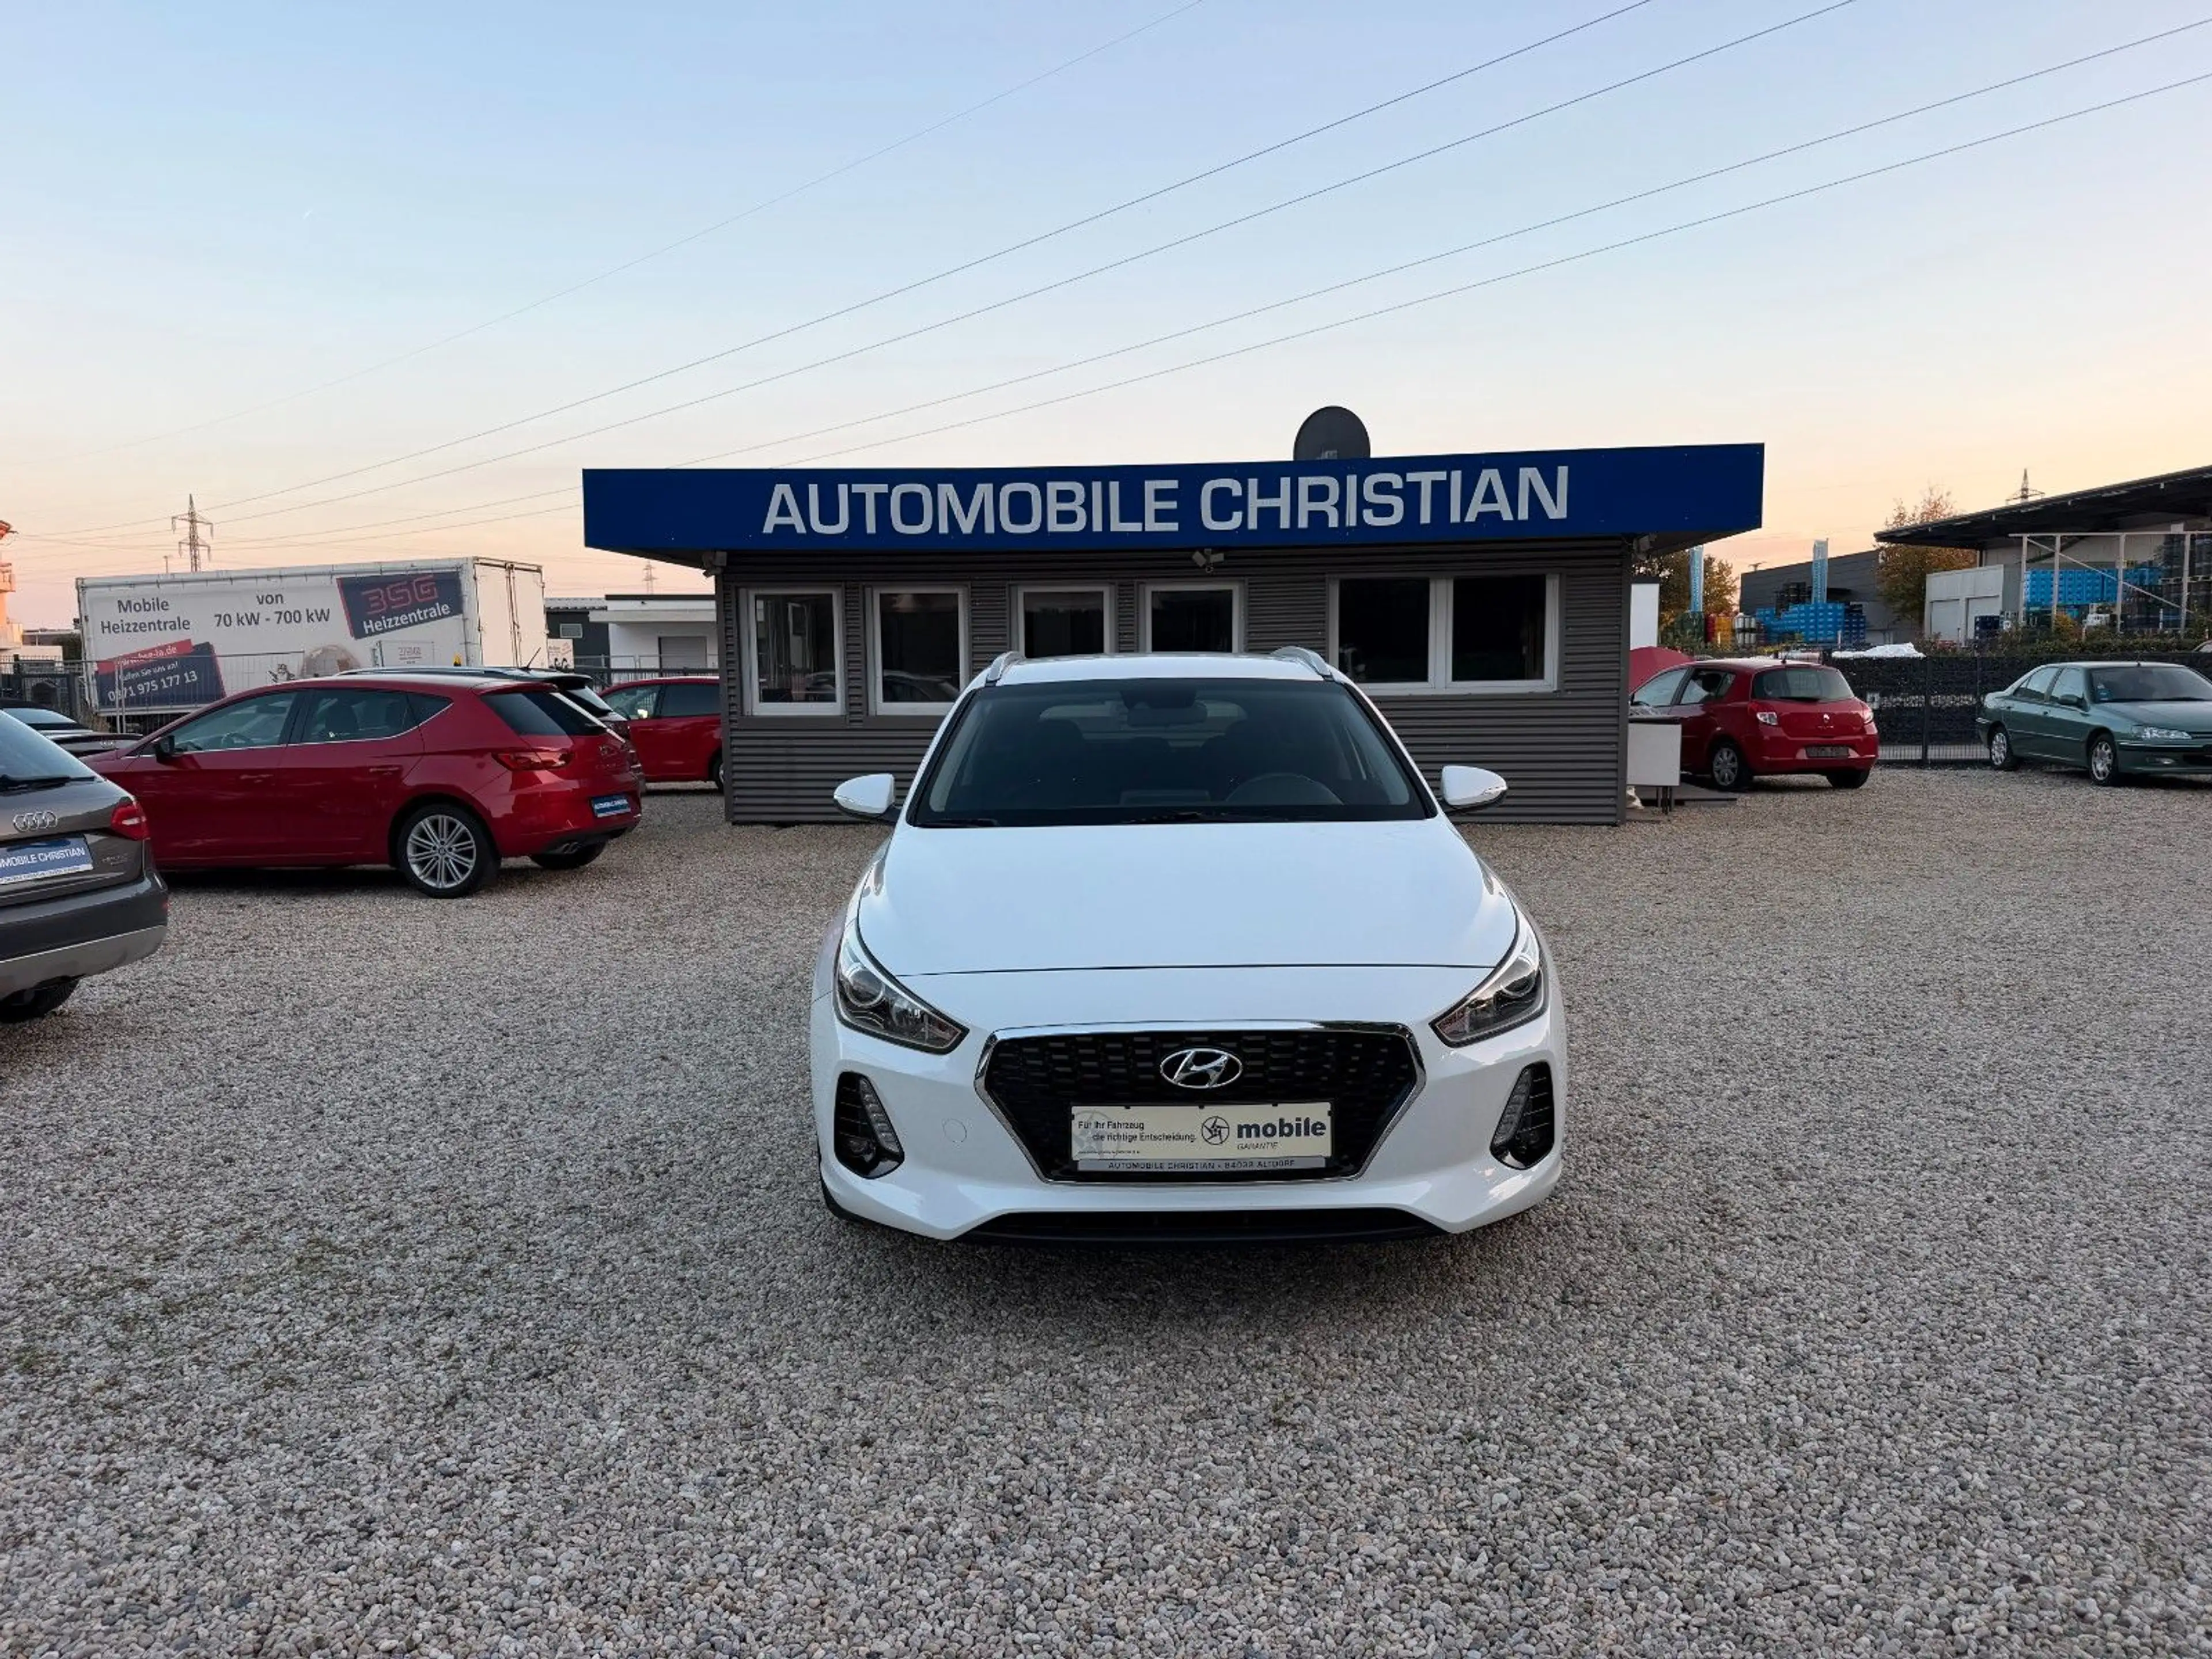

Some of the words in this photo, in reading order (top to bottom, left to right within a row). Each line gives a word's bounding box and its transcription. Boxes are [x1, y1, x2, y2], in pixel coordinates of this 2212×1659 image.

[763, 480, 1179, 535] AUTOMOBILE
[1200, 465, 1569, 532] CHRISTIAN
[117, 597, 169, 613] Mobile
[256, 594, 284, 605] von
[101, 616, 191, 634] Heizzentrale
[214, 613, 232, 627] 70
[237, 612, 260, 626] kW
[274, 610, 302, 624] 700
[306, 608, 331, 623] kW
[363, 603, 450, 634] Heizzentrale
[137, 680, 159, 695] 975
[161, 674, 180, 688] 177
[184, 670, 198, 684] 13
[0, 854, 37, 868] MOBILE
[39, 847, 85, 862] CHRISTIAN
[1107, 1120, 1144, 1131] Fahrzeug
[1237, 1117, 1327, 1138] mobile
[1092, 1132, 1105, 1141] die
[1107, 1132, 1138, 1143] richtige
[1237, 1141, 1278, 1150] GARANTIE
